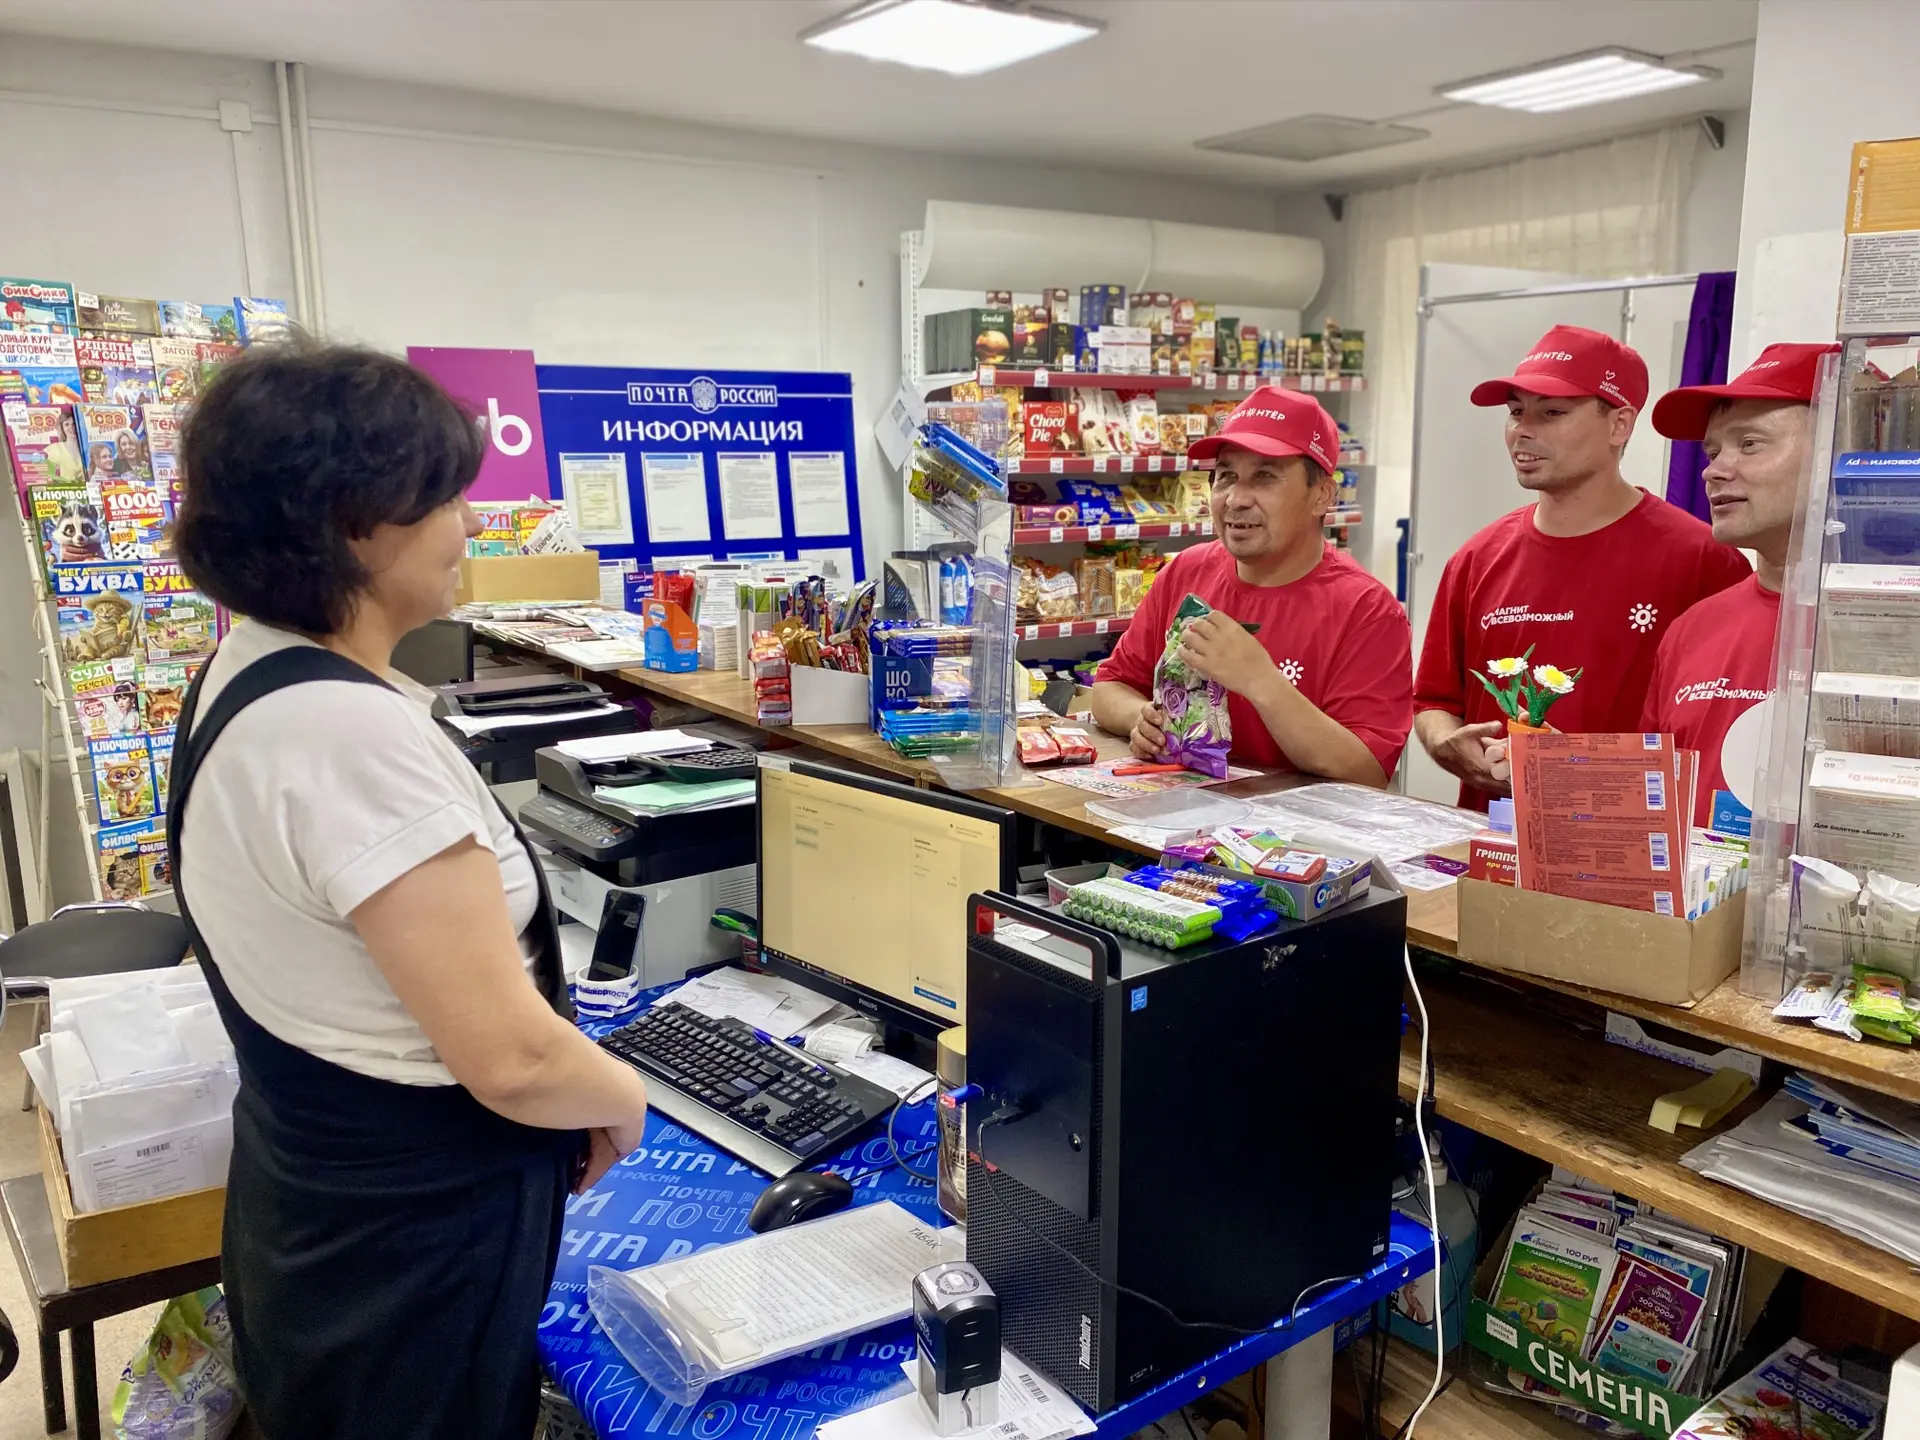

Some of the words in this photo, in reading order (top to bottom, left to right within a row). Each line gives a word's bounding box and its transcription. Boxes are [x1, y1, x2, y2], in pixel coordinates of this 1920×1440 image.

[3, 285, 67, 298] ФИКСИКИ
[0, 334, 29, 344] ОЛНЫЙ
[31, 335, 52, 344] КУР
[0, 344, 52, 354] ОДГОТОВКИ
[101, 351, 133, 361] СОВЕ
[162, 346, 198, 356] ЗАГОТО
[202, 346, 227, 361] ДАЧ
[5, 355, 42, 364] ШКОЛЕ
[1746, 361, 1781, 373] НТЁР
[632, 386, 689, 402] ПОЧТА
[720, 388, 775, 404] РОССИИ
[487, 398, 532, 456] b
[1030, 414, 1065, 427] Choco
[603, 420, 804, 445] ИНФОРМАЦИЯ
[1031, 428, 1051, 442] Pie
[33, 490, 87, 501] КЛЮЧВОР
[106, 493, 160, 509] 1000
[57, 567, 89, 577] МЕГА
[143, 564, 182, 577] КРУП
[59, 574, 139, 592] БУКВА
[144, 576, 194, 591] БУК
[1491, 610, 1574, 626] ВСЕВОЗМОЖНЫЙ
[886, 670, 911, 687] ШО
[1692, 677, 1730, 691] МАГНТ
[1688, 687, 1776, 701] ВСЕВЗМОЖНЫЙ
[92, 738, 148, 752] КЛЮЧВОРД
[1813, 822, 1828, 830] Для
[140, 843, 168, 854] ФИЛВ
[1233, 836, 1247, 847] 20
[1476, 847, 1517, 863] ГРИППО
[1502, 864, 1517, 872] про
[1317, 883, 1344, 904] Orbit
[859, 998, 878, 1011] PHILIPS
[619, 1147, 717, 1174] ОЧТА
[622, 1171, 682, 1184] РОССИИ
[660, 1185, 734, 1204] ПОЧТА
[629, 1198, 756, 1235] ПОЧТ
[563, 1229, 648, 1263] ЧТА
[1565, 1247, 1582, 1258] 100
[1582, 1253, 1600, 1265] руб.
[551, 1281, 589, 1295] ПОЧТ
[1079, 1313, 1092, 1370] ThinkCentre
[859, 1341, 914, 1361] ПОЧ
[1528, 1341, 1672, 1435] СЕМЕНА
[1764, 1371, 1795, 1392] 200
